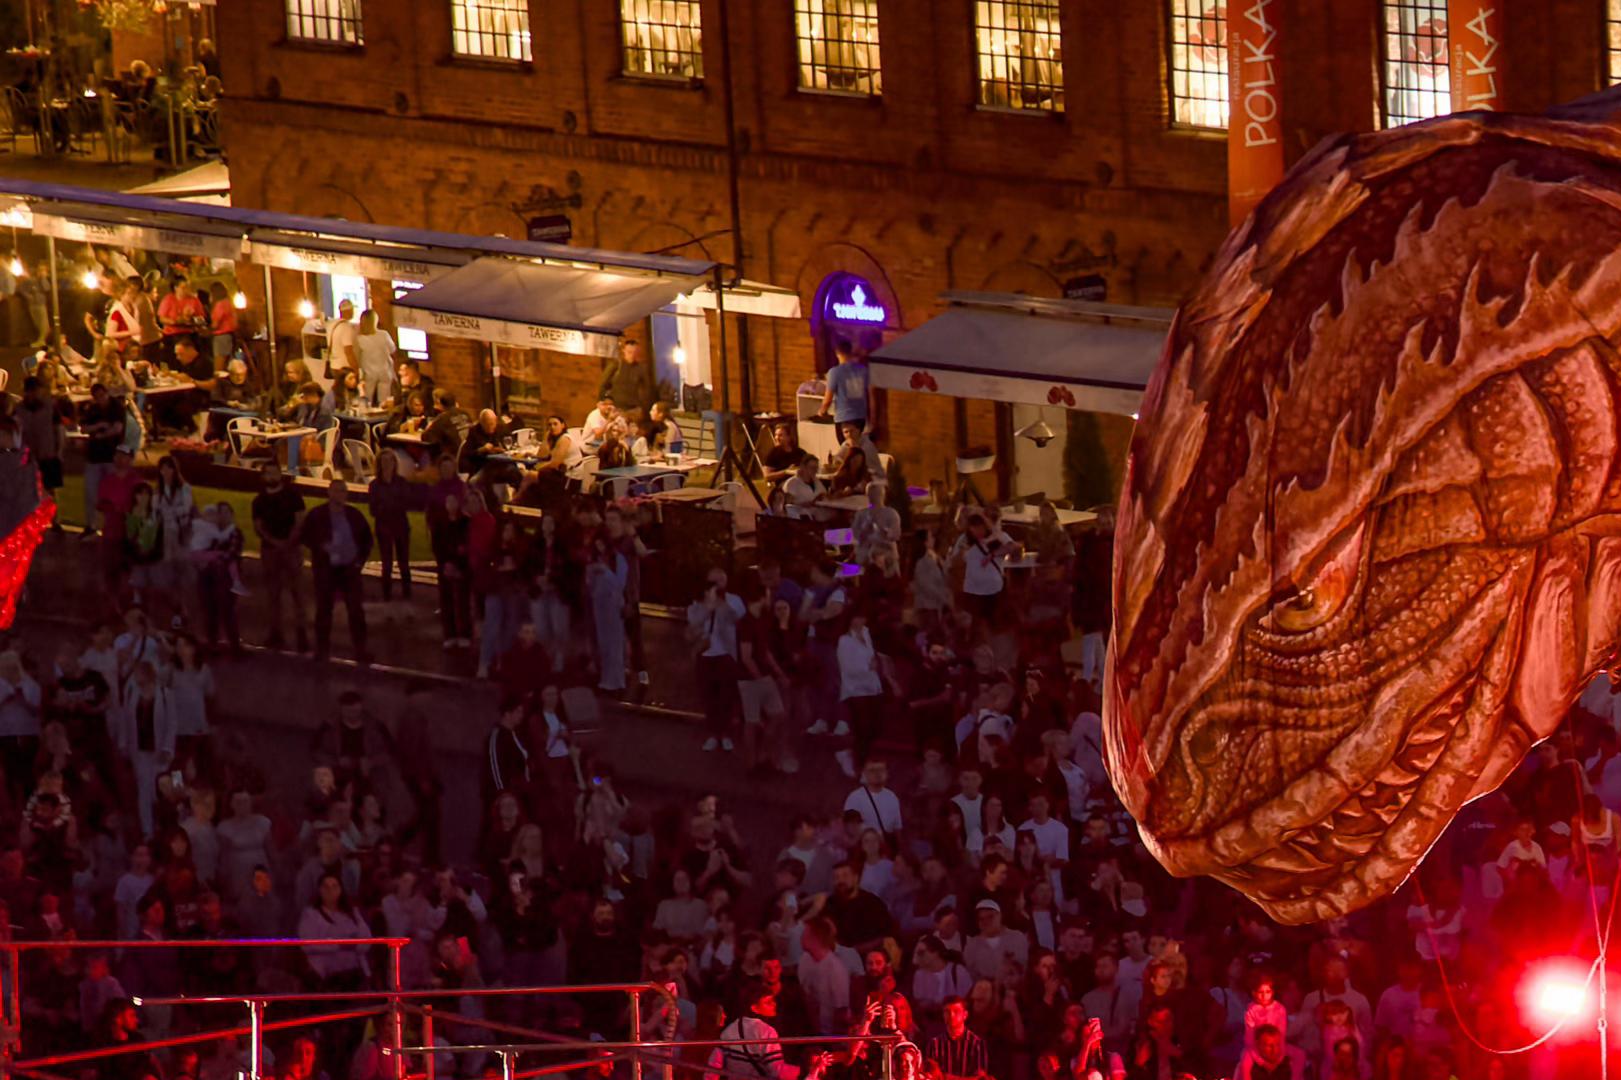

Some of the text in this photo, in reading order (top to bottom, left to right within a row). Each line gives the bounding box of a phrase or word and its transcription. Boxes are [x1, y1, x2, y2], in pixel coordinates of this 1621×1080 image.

[1244, 0, 1277, 148] POLKA
[1465, 8, 1499, 112] LKA
[431, 312, 481, 331] TAWERNA
